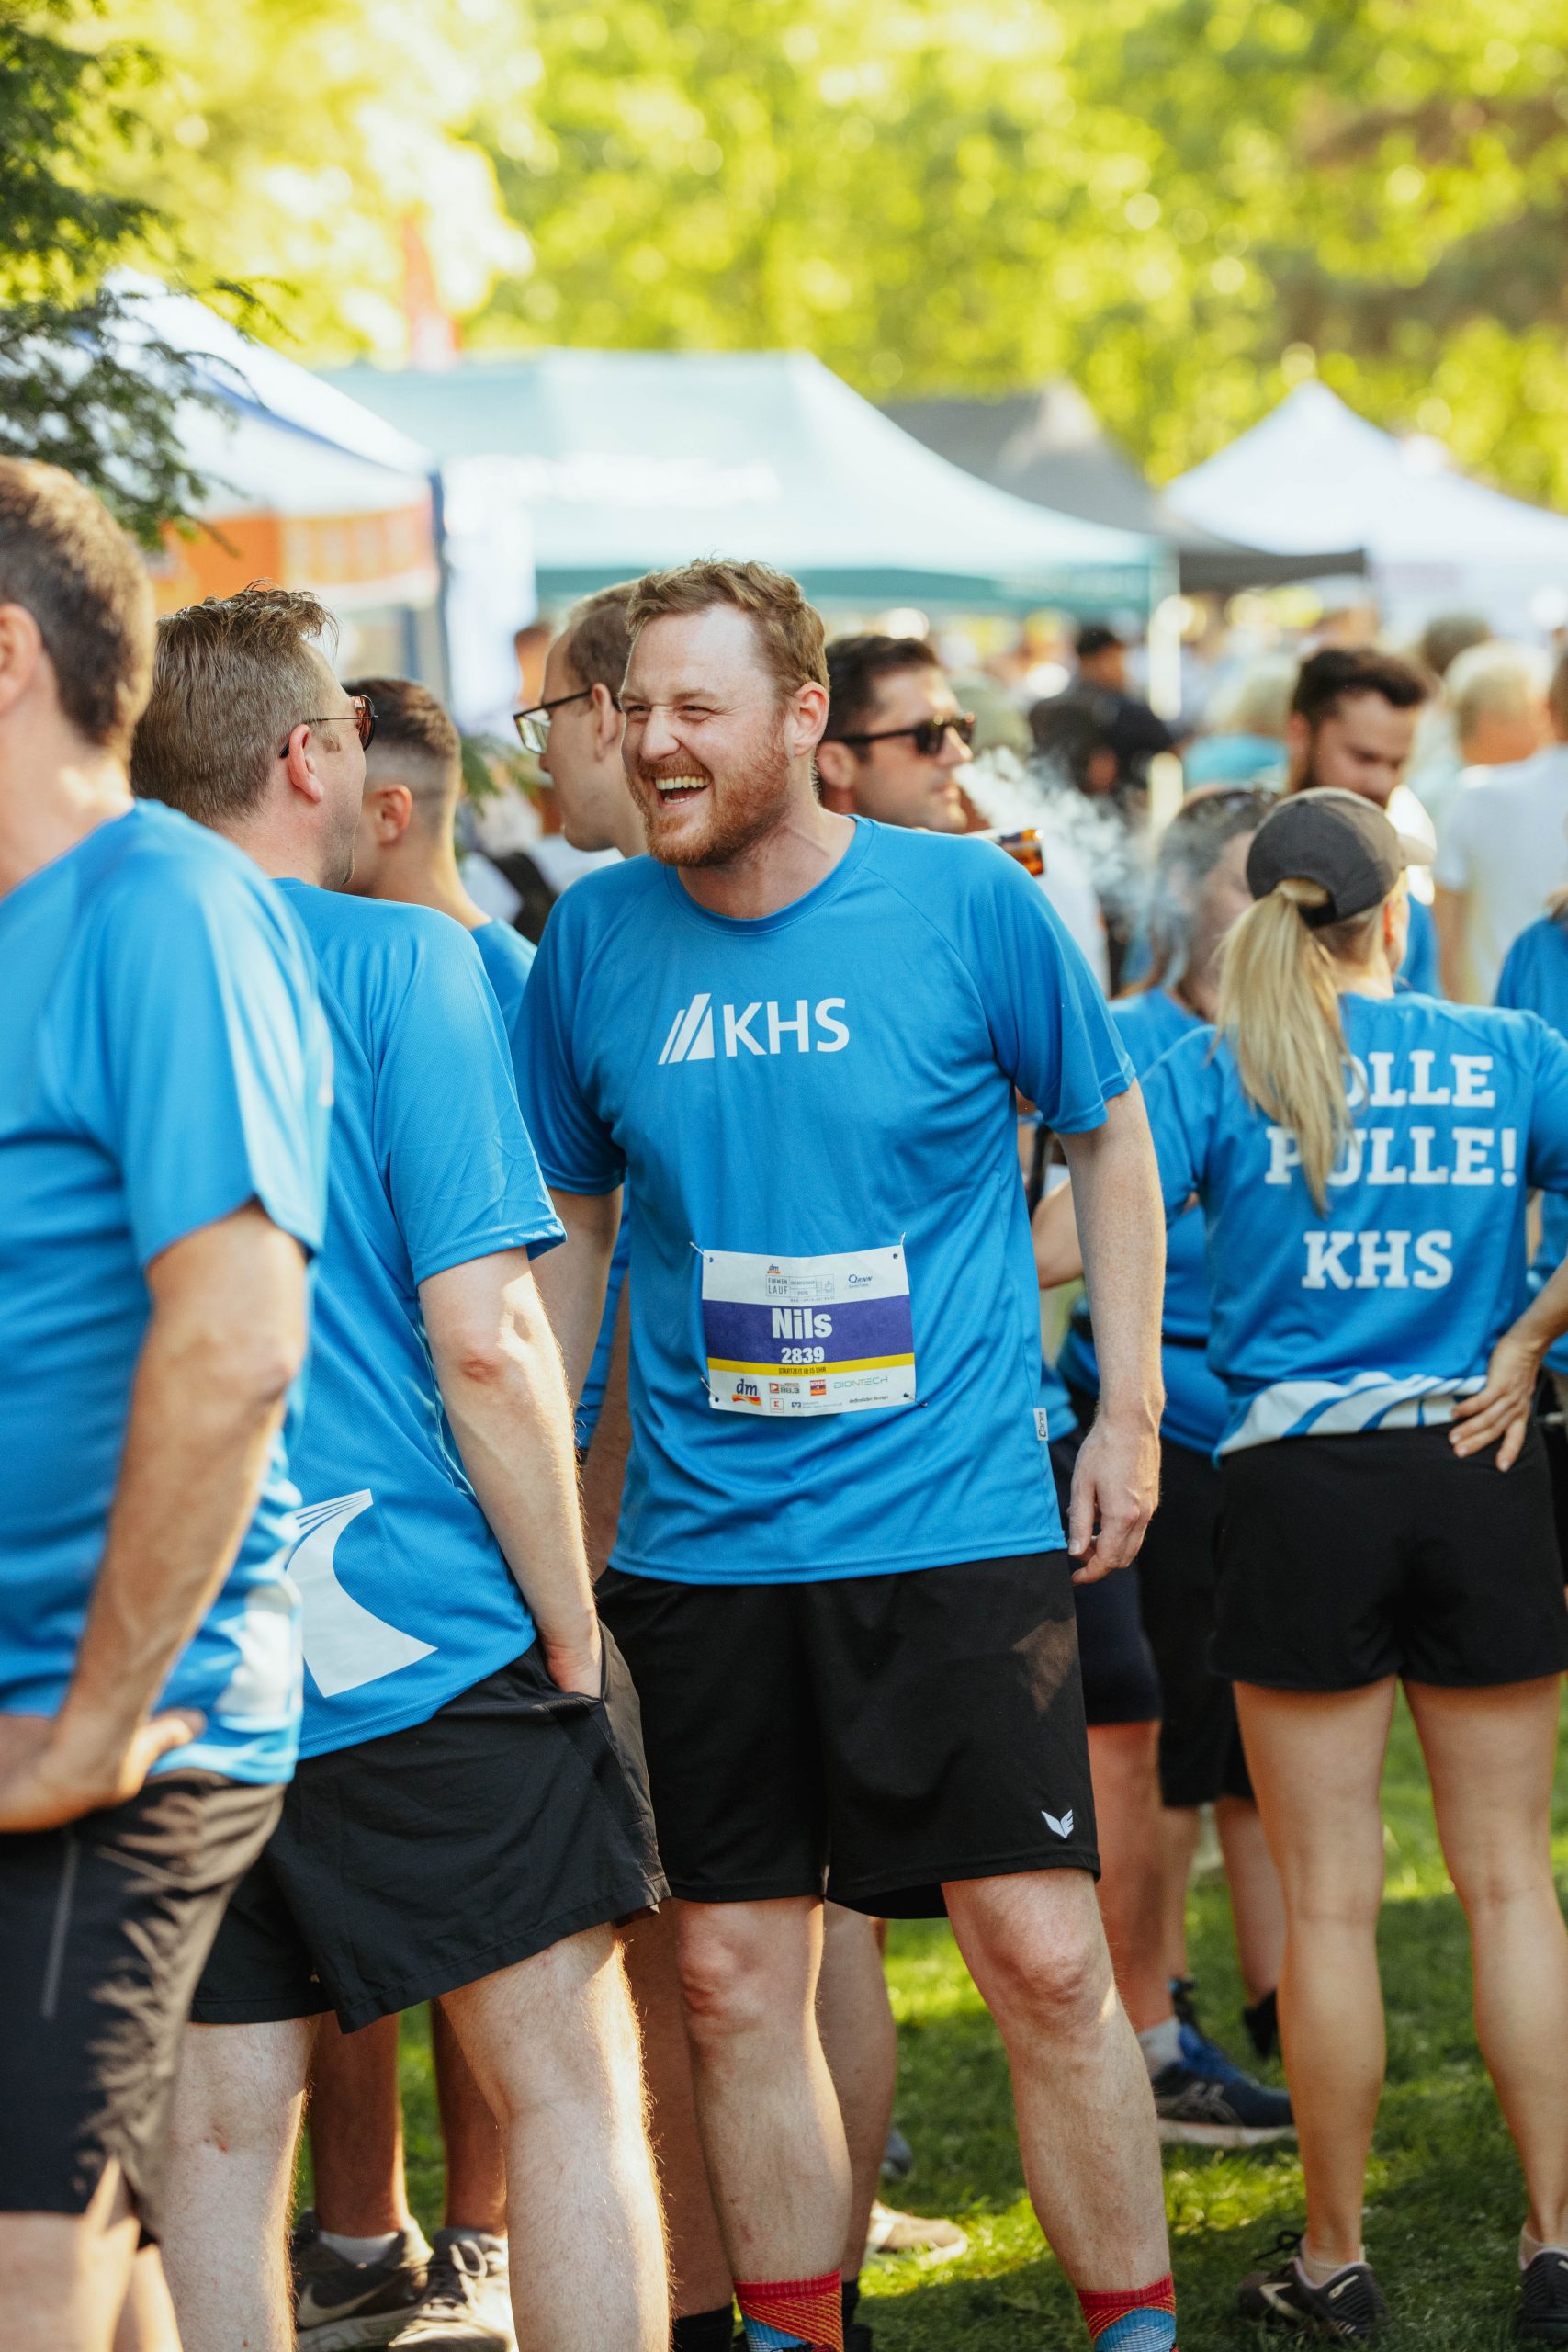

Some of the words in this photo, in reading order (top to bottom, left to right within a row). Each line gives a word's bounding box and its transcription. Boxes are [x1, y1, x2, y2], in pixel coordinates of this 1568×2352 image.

[723, 997, 850, 1057] KHS
[1339, 1050, 1495, 1108] OLLE
[1302, 1231, 1453, 1290] KHS
[768, 1285, 787, 1295] LAUF
[772, 1307, 832, 1339] Nils
[781, 1346, 825, 1363] 2839
[736, 1378, 758, 1396] dm
[833, 1374, 888, 1388] BIONTECH
